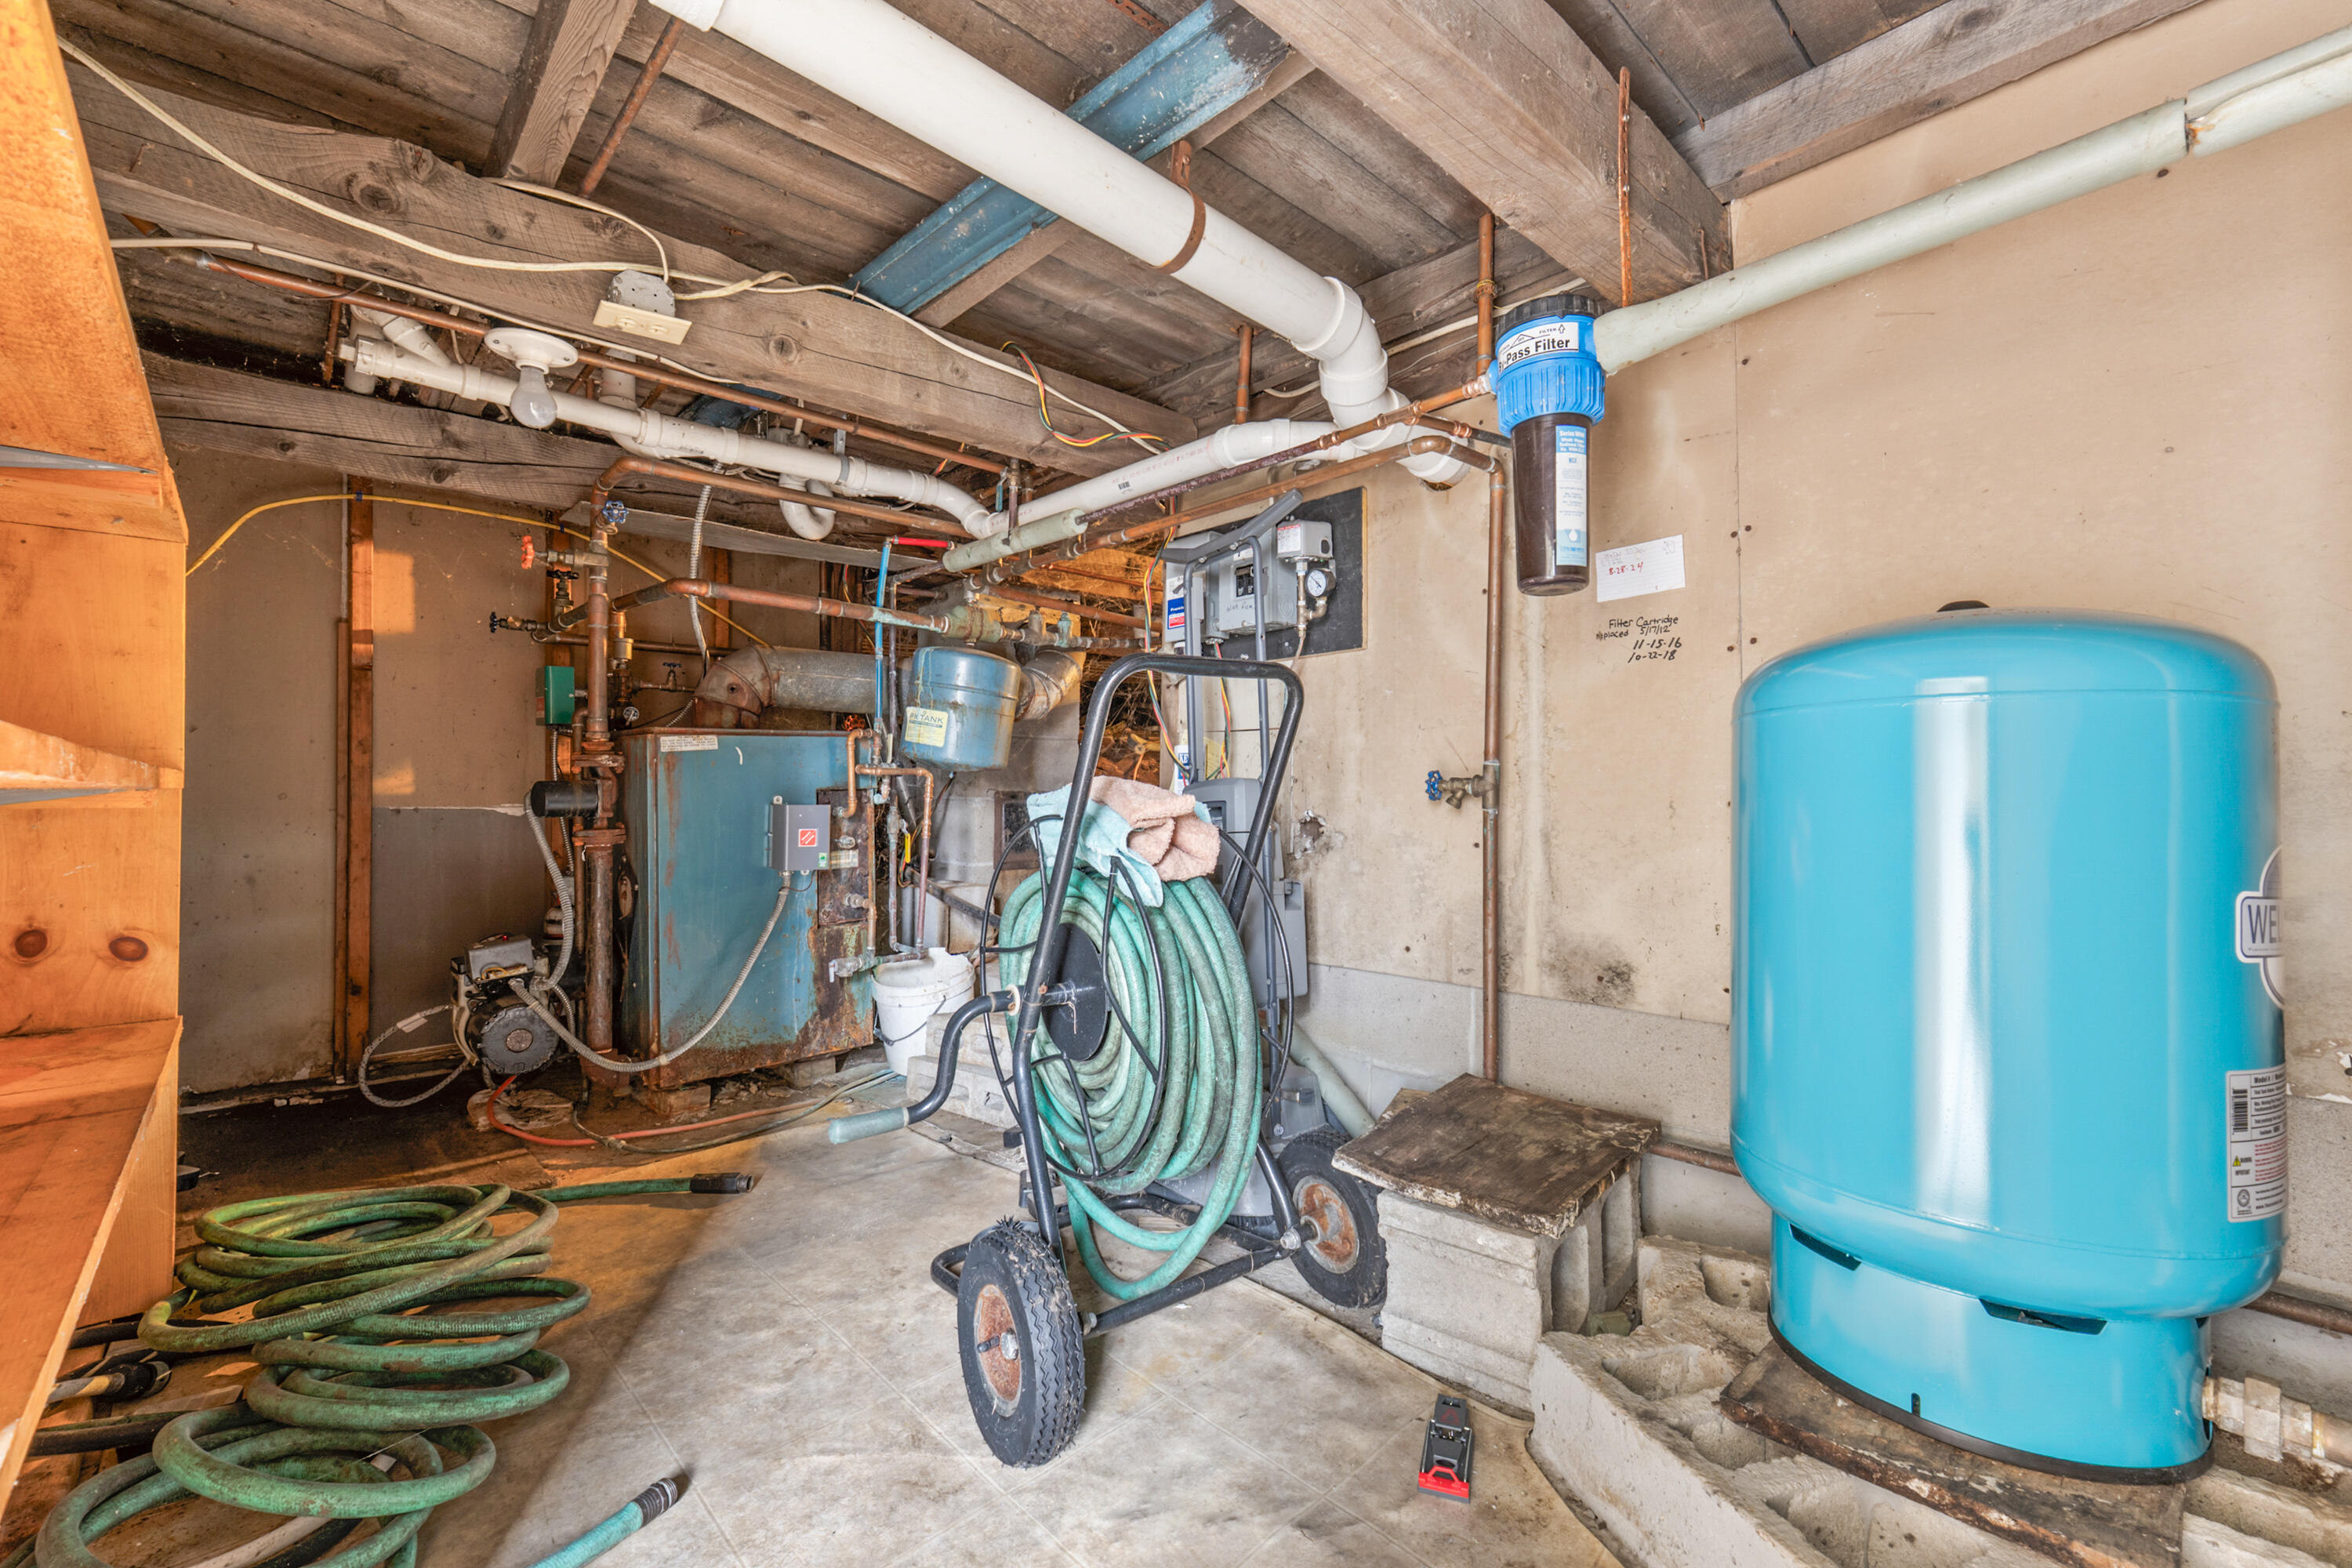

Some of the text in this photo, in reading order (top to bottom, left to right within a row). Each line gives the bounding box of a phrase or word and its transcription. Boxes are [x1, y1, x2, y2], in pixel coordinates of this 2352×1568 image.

[1535, 338, 1570, 352] Filter
[1609, 614, 1679, 629] Filter Cartridge
[1639, 625, 1671, 636] 5/17/12
[1633, 637, 1682, 650] 11-15-16
[1628, 649, 1677, 663] 10-22-18
[920, 714, 944, 724] TANK
